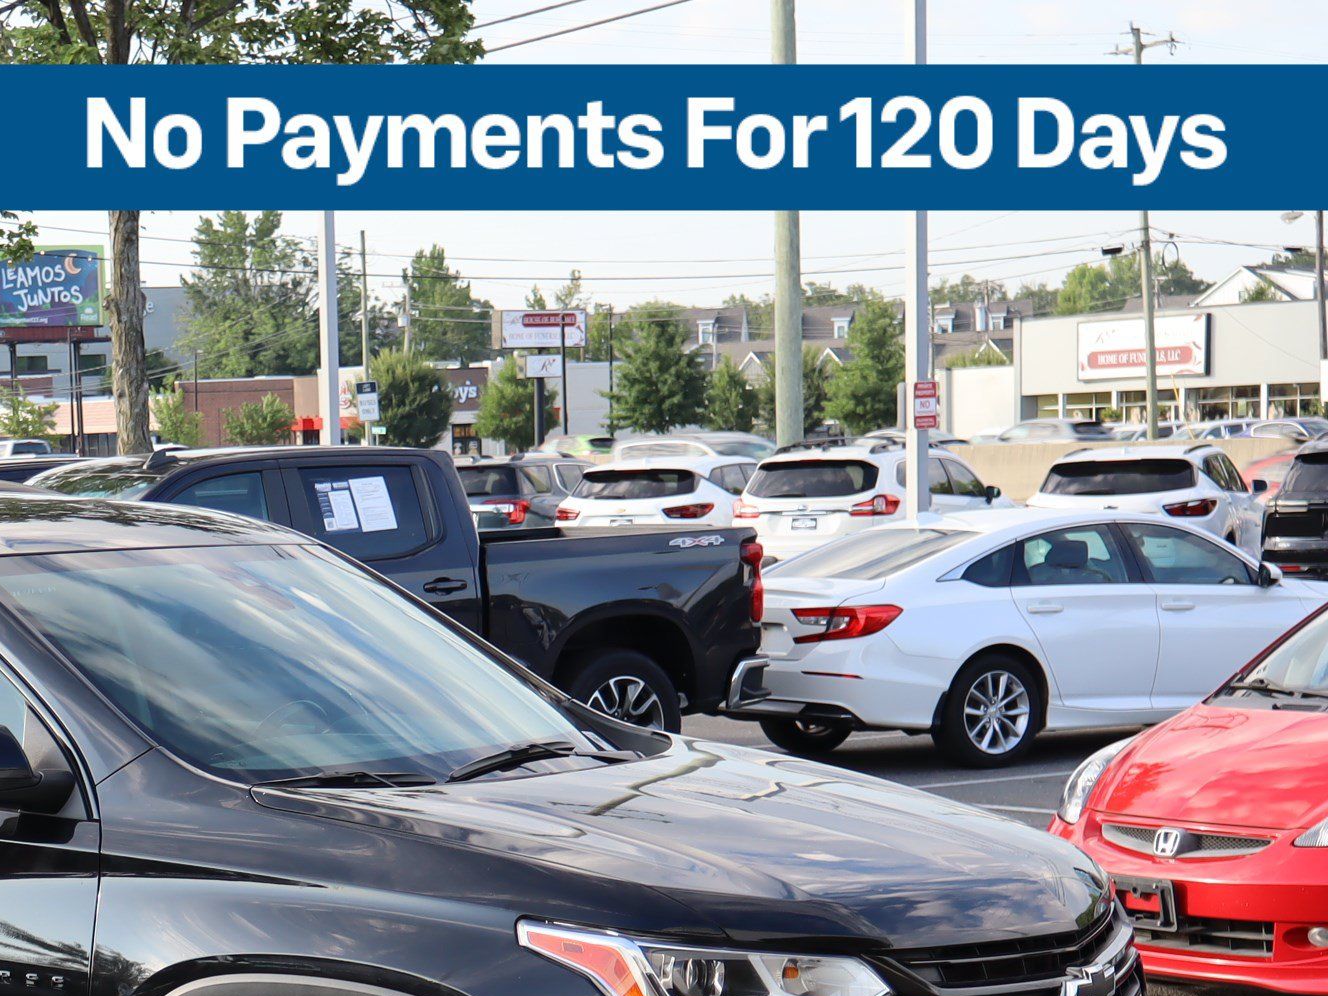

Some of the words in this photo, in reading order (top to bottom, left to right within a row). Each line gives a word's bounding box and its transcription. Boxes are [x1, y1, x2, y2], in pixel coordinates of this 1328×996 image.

[1, 264, 66, 290] LEAMOS
[1097, 353, 1118, 365] HOME
[1119, 352, 1128, 364] OF
[920, 400, 931, 409] NO
